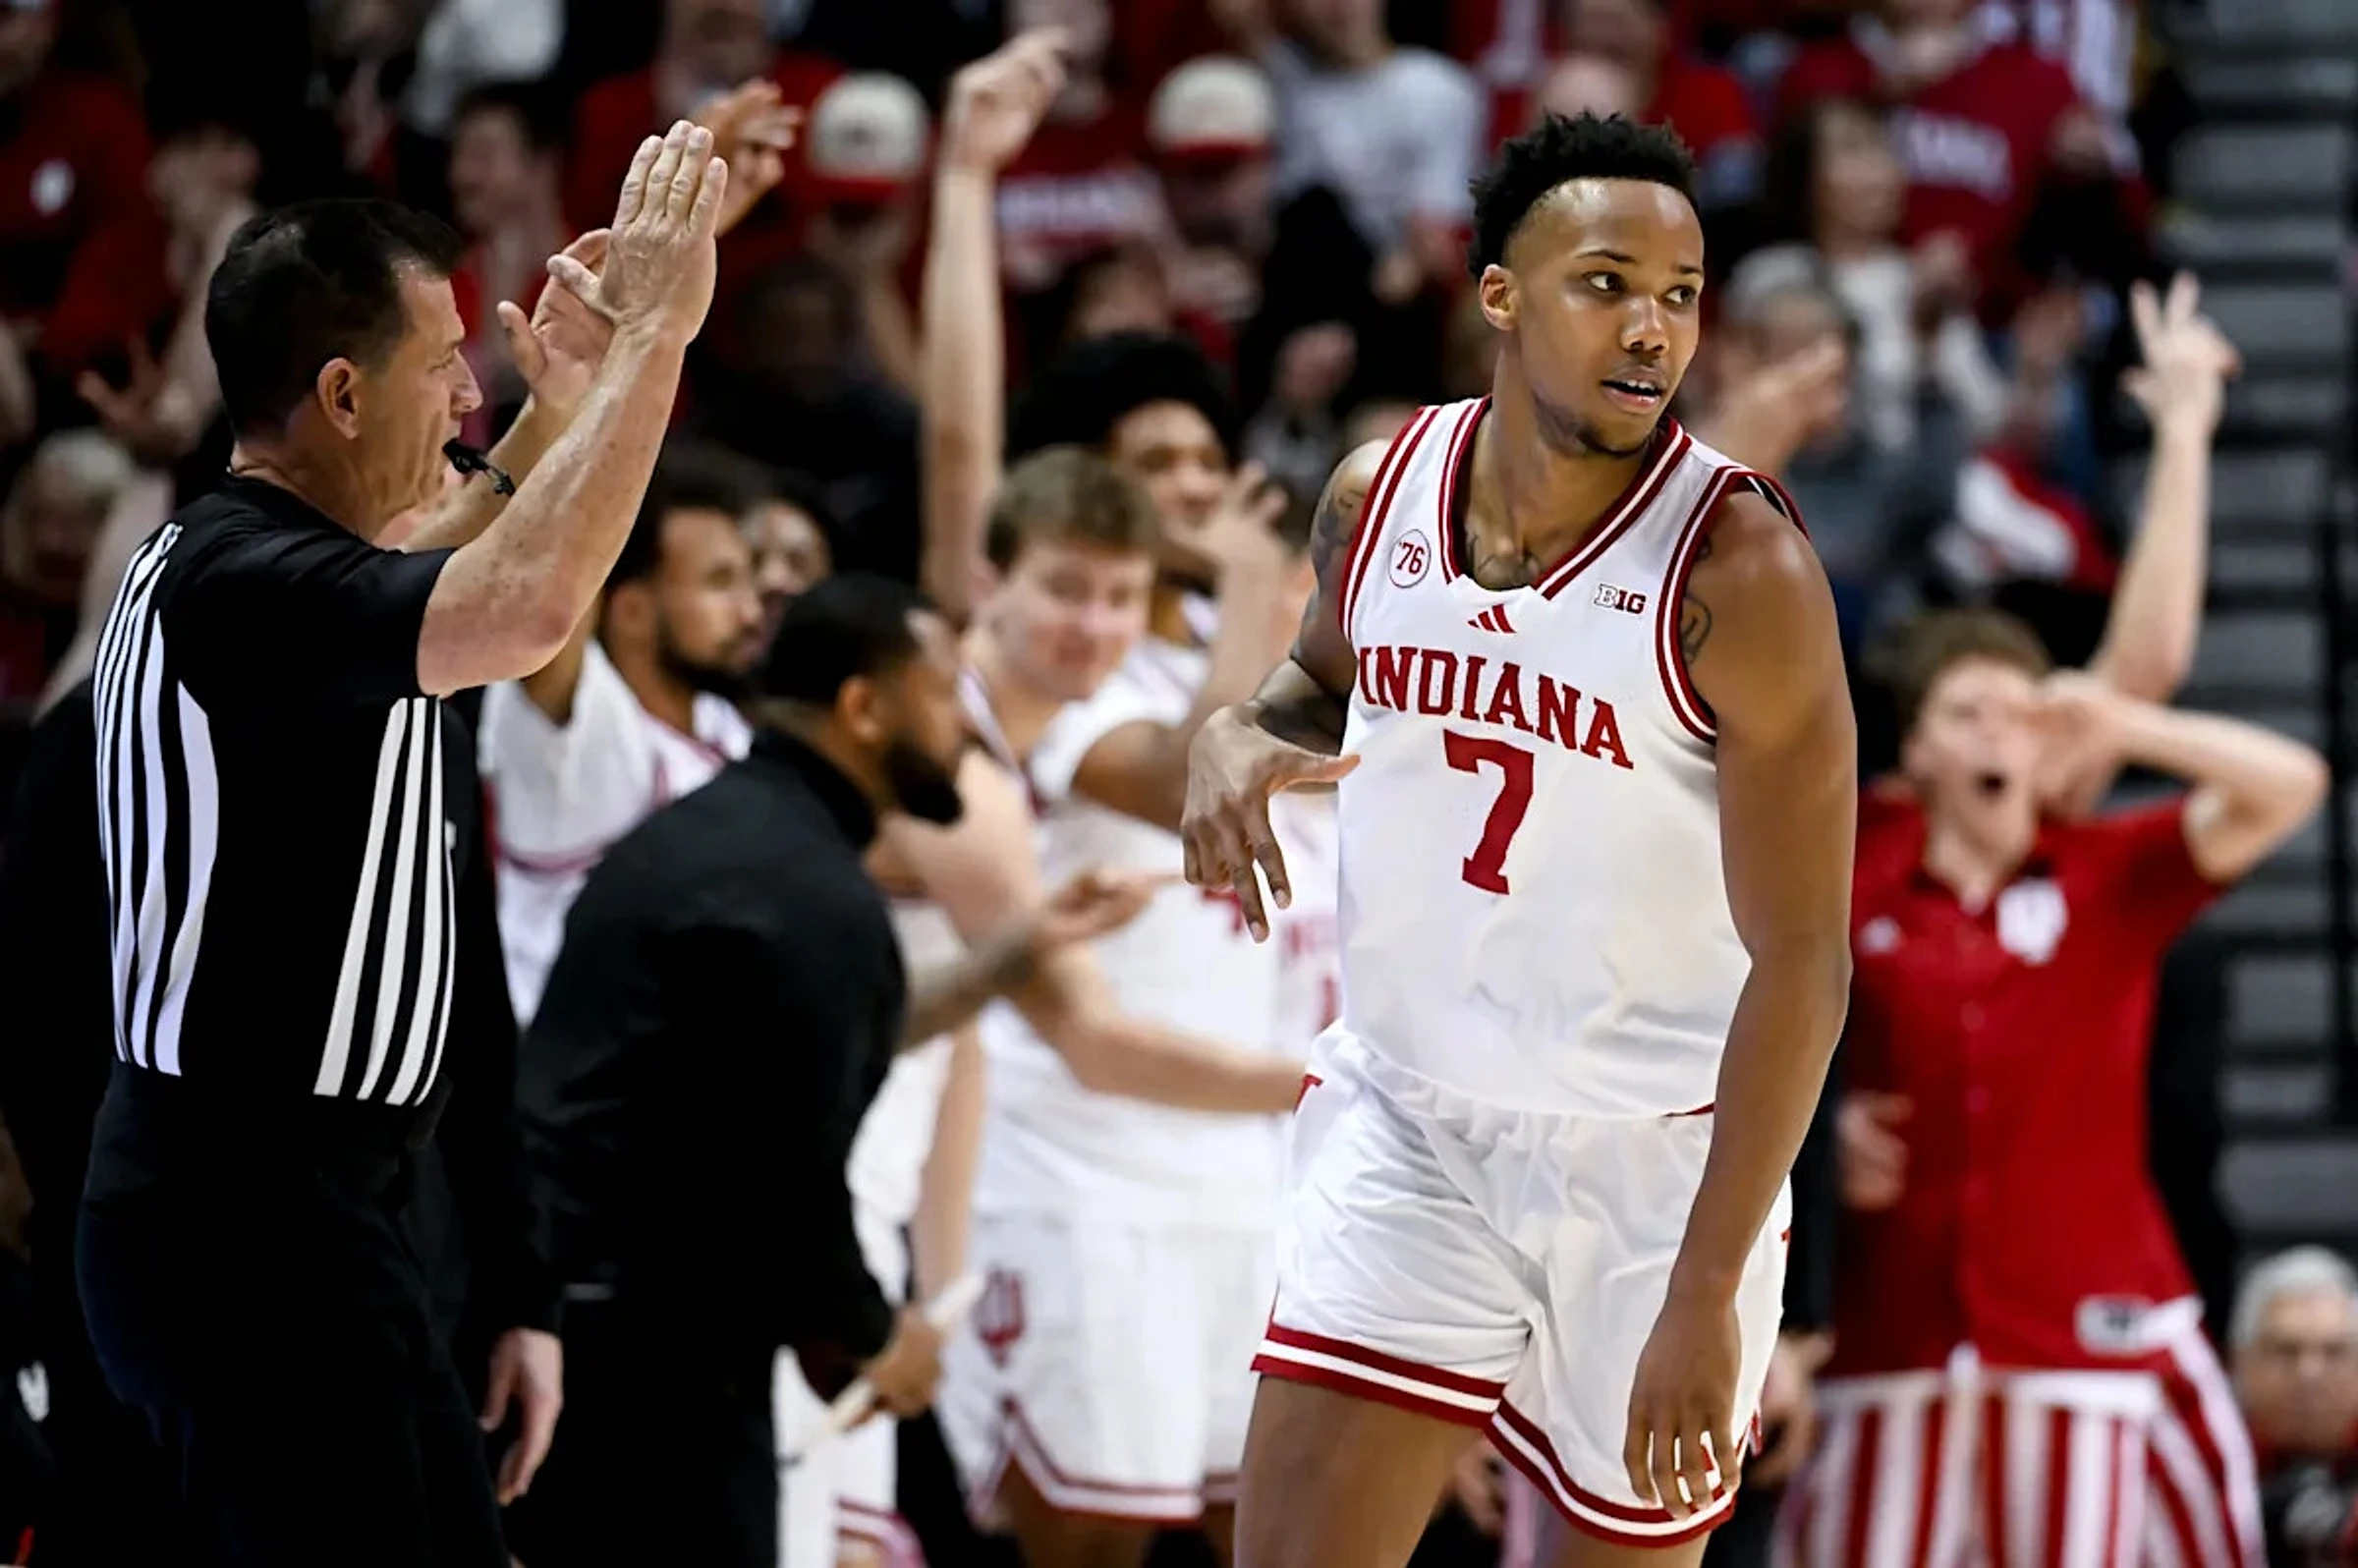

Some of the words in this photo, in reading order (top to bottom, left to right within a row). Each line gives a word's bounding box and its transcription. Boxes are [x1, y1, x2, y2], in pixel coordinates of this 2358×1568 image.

[1594, 584, 1647, 614] BIG
[1359, 645, 1634, 769] INDIANA
[1443, 729, 1535, 895] 7
